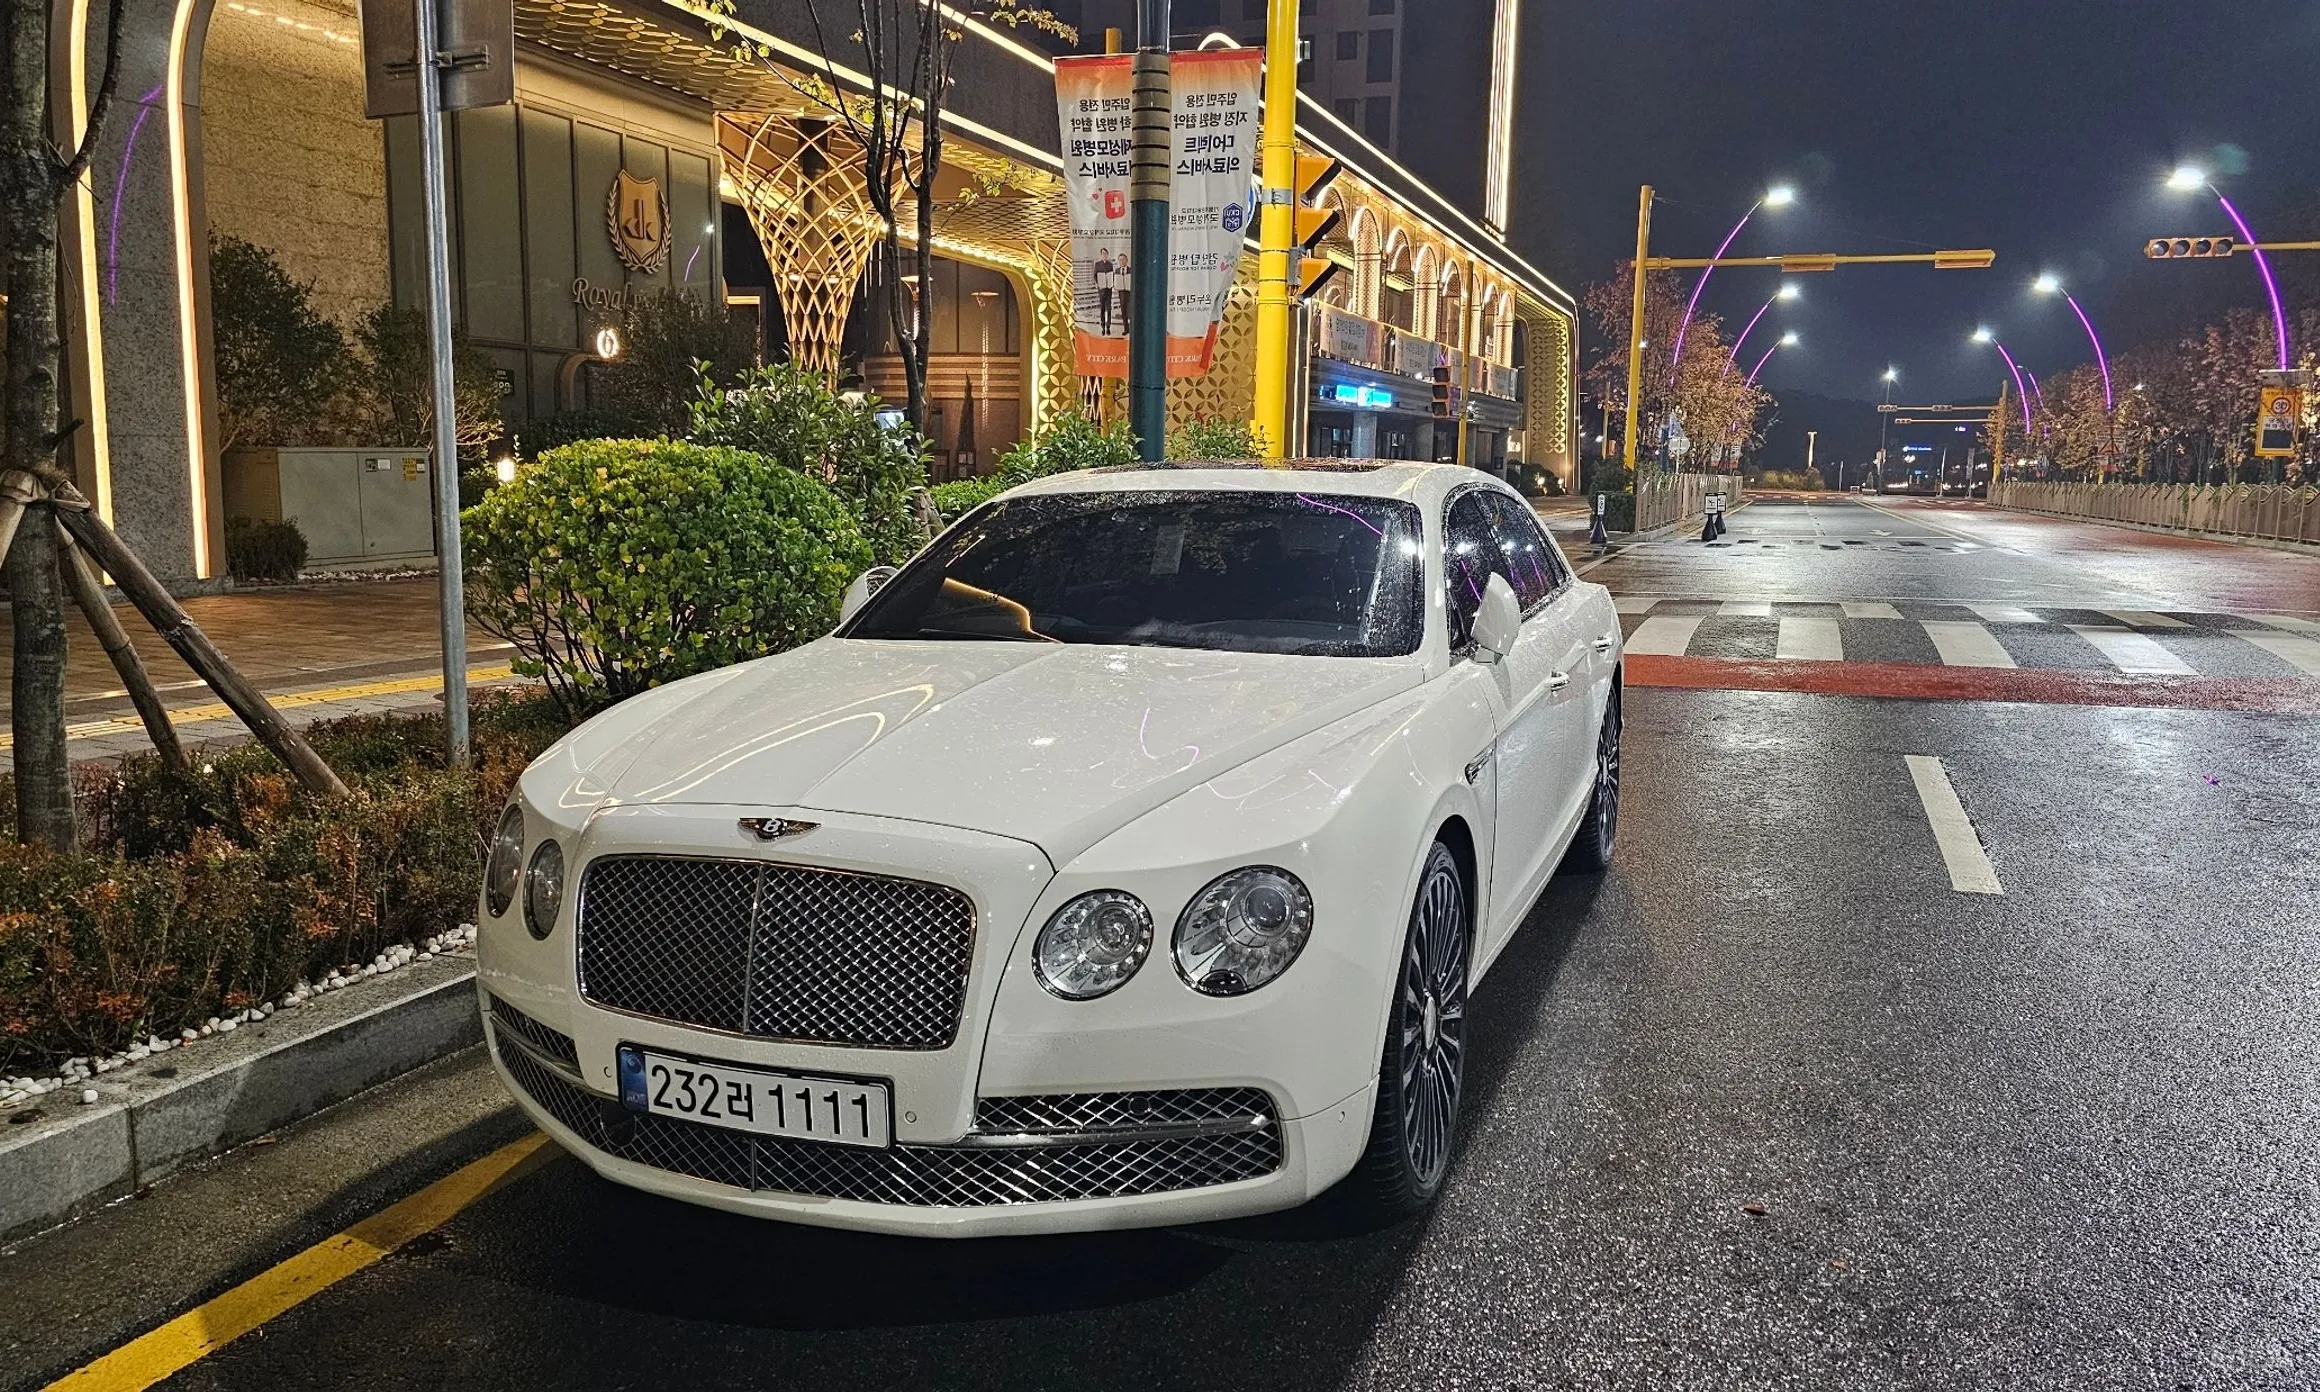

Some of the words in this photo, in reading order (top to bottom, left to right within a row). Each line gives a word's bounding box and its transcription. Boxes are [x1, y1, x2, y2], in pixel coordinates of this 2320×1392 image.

[572, 277, 633, 312] Royal
[651, 1064, 754, 1123] 232러
[768, 1083, 870, 1138] 1111
